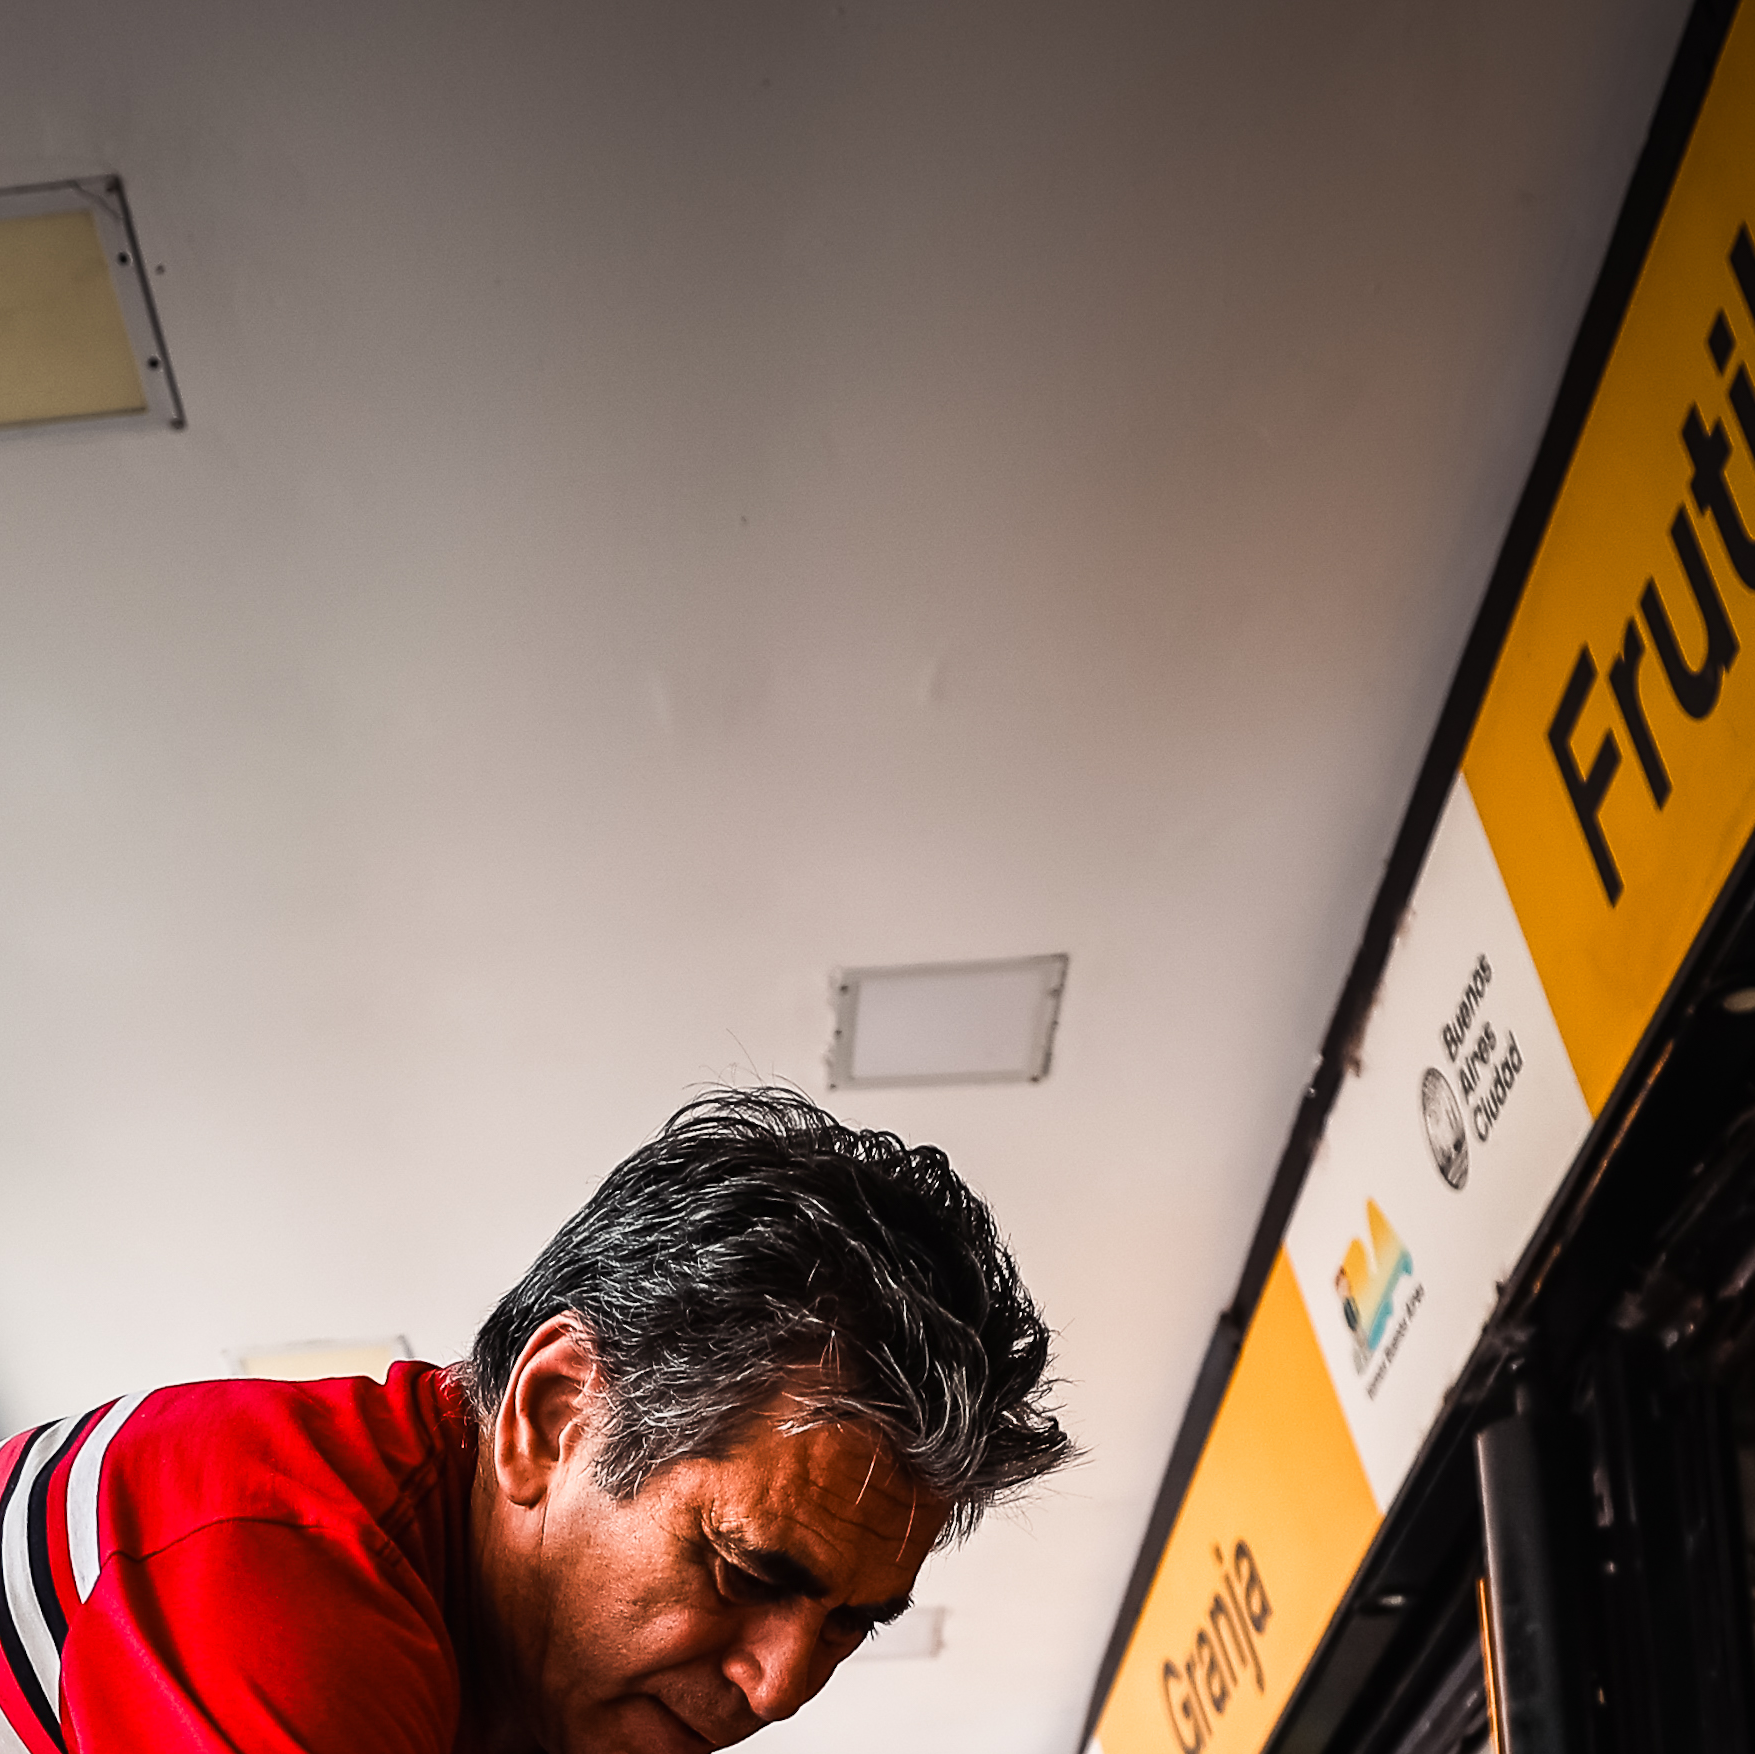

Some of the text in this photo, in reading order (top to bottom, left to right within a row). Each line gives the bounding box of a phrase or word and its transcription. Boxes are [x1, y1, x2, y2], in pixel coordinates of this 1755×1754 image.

[1442, 953, 1494, 1063] Buenos
[1459, 1021, 1497, 1105] Aires
[1473, 1029, 1525, 1143] Ciudad
